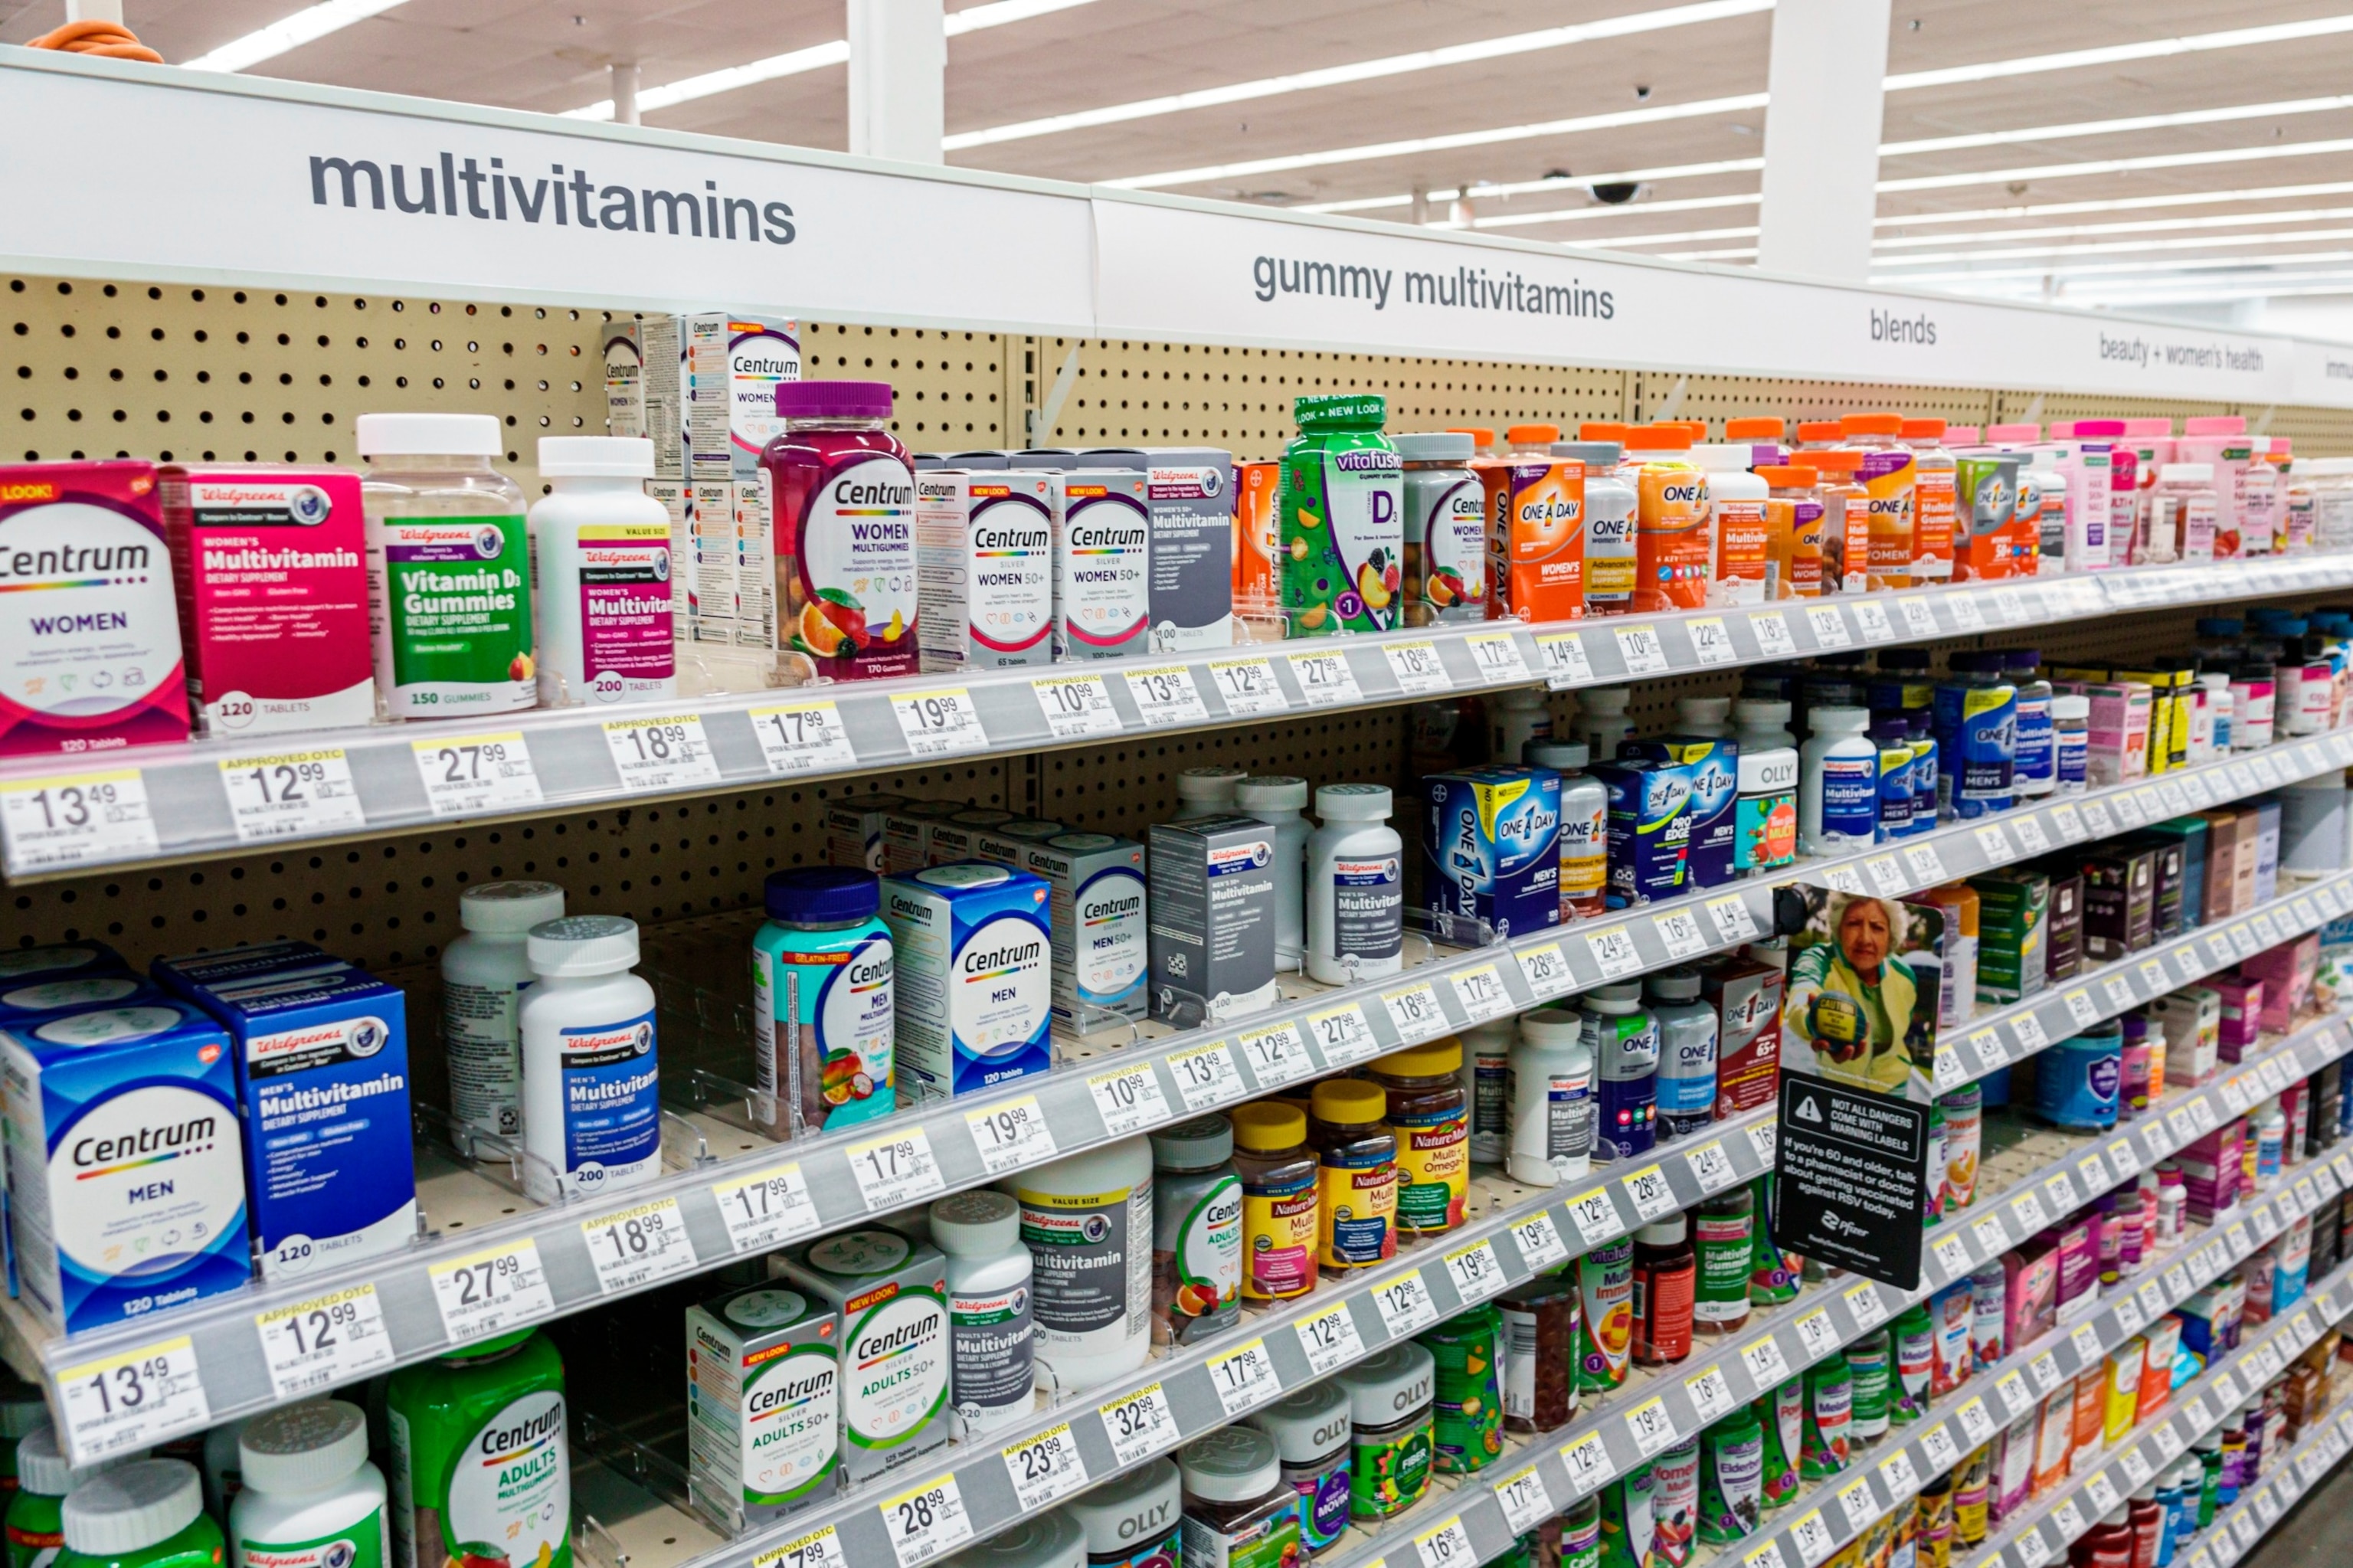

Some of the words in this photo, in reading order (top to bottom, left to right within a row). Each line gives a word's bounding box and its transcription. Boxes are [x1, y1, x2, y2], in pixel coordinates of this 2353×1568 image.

[309, 151, 797, 244] multivitamins
[1253, 254, 1392, 310] gummy
[1405, 266, 1615, 319] multivitamins
[1870, 309, 1937, 345] blends
[2099, 332, 2149, 368] beauty
[2166, 343, 2223, 369] women's
[2225, 346, 2264, 372] health
[734, 356, 798, 375] Centrum
[1153, 471, 1199, 483] Walgreens
[201, 488, 287, 503] Walgreens
[835, 480, 912, 505] Centrum
[919, 483, 956, 496] Centrum
[1664, 486, 1695, 501] ONE
[1523, 505, 1543, 520] ONE
[1556, 503, 1579, 518] DAY
[1869, 500, 1900, 514] ONE
[626, 527, 651, 535] VALUE
[1154, 514, 1230, 529] Multivitamin
[1593, 520, 1625, 535] ONE
[400, 529, 472, 542] Walgreens
[852, 523, 909, 540] WOMEN
[975, 528, 1048, 548] Centrum
[1072, 526, 1144, 546] Centrum
[203, 537, 259, 547] WOMEN'S
[204, 547, 358, 570] Multivitamin
[586, 552, 652, 565] Walgreens
[1541, 561, 1580, 575] WOMEN'S
[1592, 560, 1625, 568] Advanced
[401, 568, 500, 594] Vitamin
[977, 573, 1023, 586] WOMEN
[1025, 572, 1045, 584] 50+
[1074, 571, 1118, 583] WOMEN
[1120, 570, 1141, 581] 50+
[404, 591, 515, 615] Gummies
[31, 611, 129, 636] WOMEN
[596, 680, 622, 692] 200
[412, 693, 438, 705] 150
[444, 691, 492, 704] GUMMIES
[221, 701, 253, 715] 120
[263, 702, 310, 714] TABLETS
[608, 719, 671, 731] APPROVED
[673, 715, 698, 724] OTC
[61, 738, 87, 752] 120
[89, 735, 127, 749] Tablets
[1977, 728, 2004, 741] ONE
[227, 753, 308, 770] APPROVED
[311, 748, 342, 760] OTC
[1761, 764, 1793, 784] OLLY
[1965, 776, 2001, 787] MEN'S
[1501, 820, 1522, 837] ONE
[1534, 812, 1555, 830] DAY
[1560, 821, 1589, 836] ONE
[1671, 817, 1691, 830] PRO
[1713, 825, 1734, 837] MEN'S
[1769, 826, 1795, 840] MULTI
[932, 827, 968, 846] Centrum
[1664, 827, 1691, 840] EDGE
[979, 837, 1017, 859] Centrum
[1028, 852, 1069, 875] Centrum
[1533, 867, 1557, 882] MEN'S
[1212, 881, 1273, 902] Multivitamin
[890, 894, 933, 921] Centrum
[1084, 895, 1140, 920] Centrum
[1092, 936, 1114, 950] MEN
[964, 941, 1041, 974] Centrum
[991, 987, 1017, 1004] MEN
[1726, 1007, 1746, 1023] ONE
[1756, 1001, 1776, 1015] DAY
[257, 1029, 344, 1054] Walgreens
[567, 1033, 633, 1051] Walgreens
[1623, 1037, 1650, 1052] ONE
[1756, 1042, 1777, 1058] 65+
[1680, 1046, 1707, 1059] ONE
[260, 1082, 294, 1096] MEN'S
[260, 1072, 404, 1118] Multivitamin
[1831, 1098, 1850, 1111] NOT
[1851, 1102, 1867, 1117] ALL
[1869, 1107, 1913, 1130] DANGERS
[1831, 1110, 1857, 1126] COME
[1859, 1117, 1883, 1133] WITH
[74, 1115, 216, 1167] Centrum
[1830, 1121, 1874, 1142] WARNING
[1874, 1132, 1909, 1152] LABELS
[1784, 1137, 1793, 1147] If
[1793, 1139, 1824, 1157] you're
[1825, 1148, 1841, 1161] 60
[1842, 1154, 1863, 1167] and
[1864, 1159, 1894, 1179] older,
[1896, 1169, 1917, 1183] talk
[578, 1169, 604, 1182] 200
[610, 1163, 645, 1178] TABLETS
[1785, 1150, 1796, 1162] to
[1805, 1155, 1864, 1181] pharmacist
[1867, 1174, 1877, 1184] or
[1878, 1177, 1915, 1196] doctor
[128, 1179, 174, 1205] MEN
[1784, 1163, 1814, 1180] about
[1815, 1172, 1853, 1194] getting
[1854, 1184, 1914, 1210] vaccinated
[1052, 1196, 1079, 1206] VALUE
[1082, 1195, 1100, 1204] SIZE
[1798, 1180, 1837, 1202] against
[1838, 1192, 1861, 1207] RSV
[1863, 1200, 1896, 1219] today.
[587, 1206, 648, 1231] APPROVED
[648, 1196, 675, 1212] OTC
[1023, 1211, 1081, 1228] Walgreens
[279, 1243, 313, 1263] 120
[319, 1233, 363, 1252] TABLETS
[123, 1297, 152, 1316] 120
[262, 1295, 342, 1324] APPROVED
[342, 1284, 373, 1300] OTC
[955, 1298, 1009, 1312] Walgreens
[696, 1325, 731, 1357] Centrum
[857, 1312, 938, 1360] Centrum
[1051, 1334, 1082, 1343] TABLETS
[885, 1353, 914, 1371] SILVER
[861, 1367, 912, 1399] ADULTS
[912, 1359, 935, 1377] 50+
[749, 1370, 833, 1413] Centrum
[1392, 1376, 1431, 1412] OLLY
[778, 1407, 808, 1423] SILVER
[481, 1401, 561, 1455] Centrum
[752, 1419, 805, 1449] ADULTS
[806, 1411, 830, 1429] 50+
[1312, 1413, 1349, 1446] OLLY
[499, 1445, 557, 1488] ADULTS
[1118, 1499, 1170, 1540] OLLY
